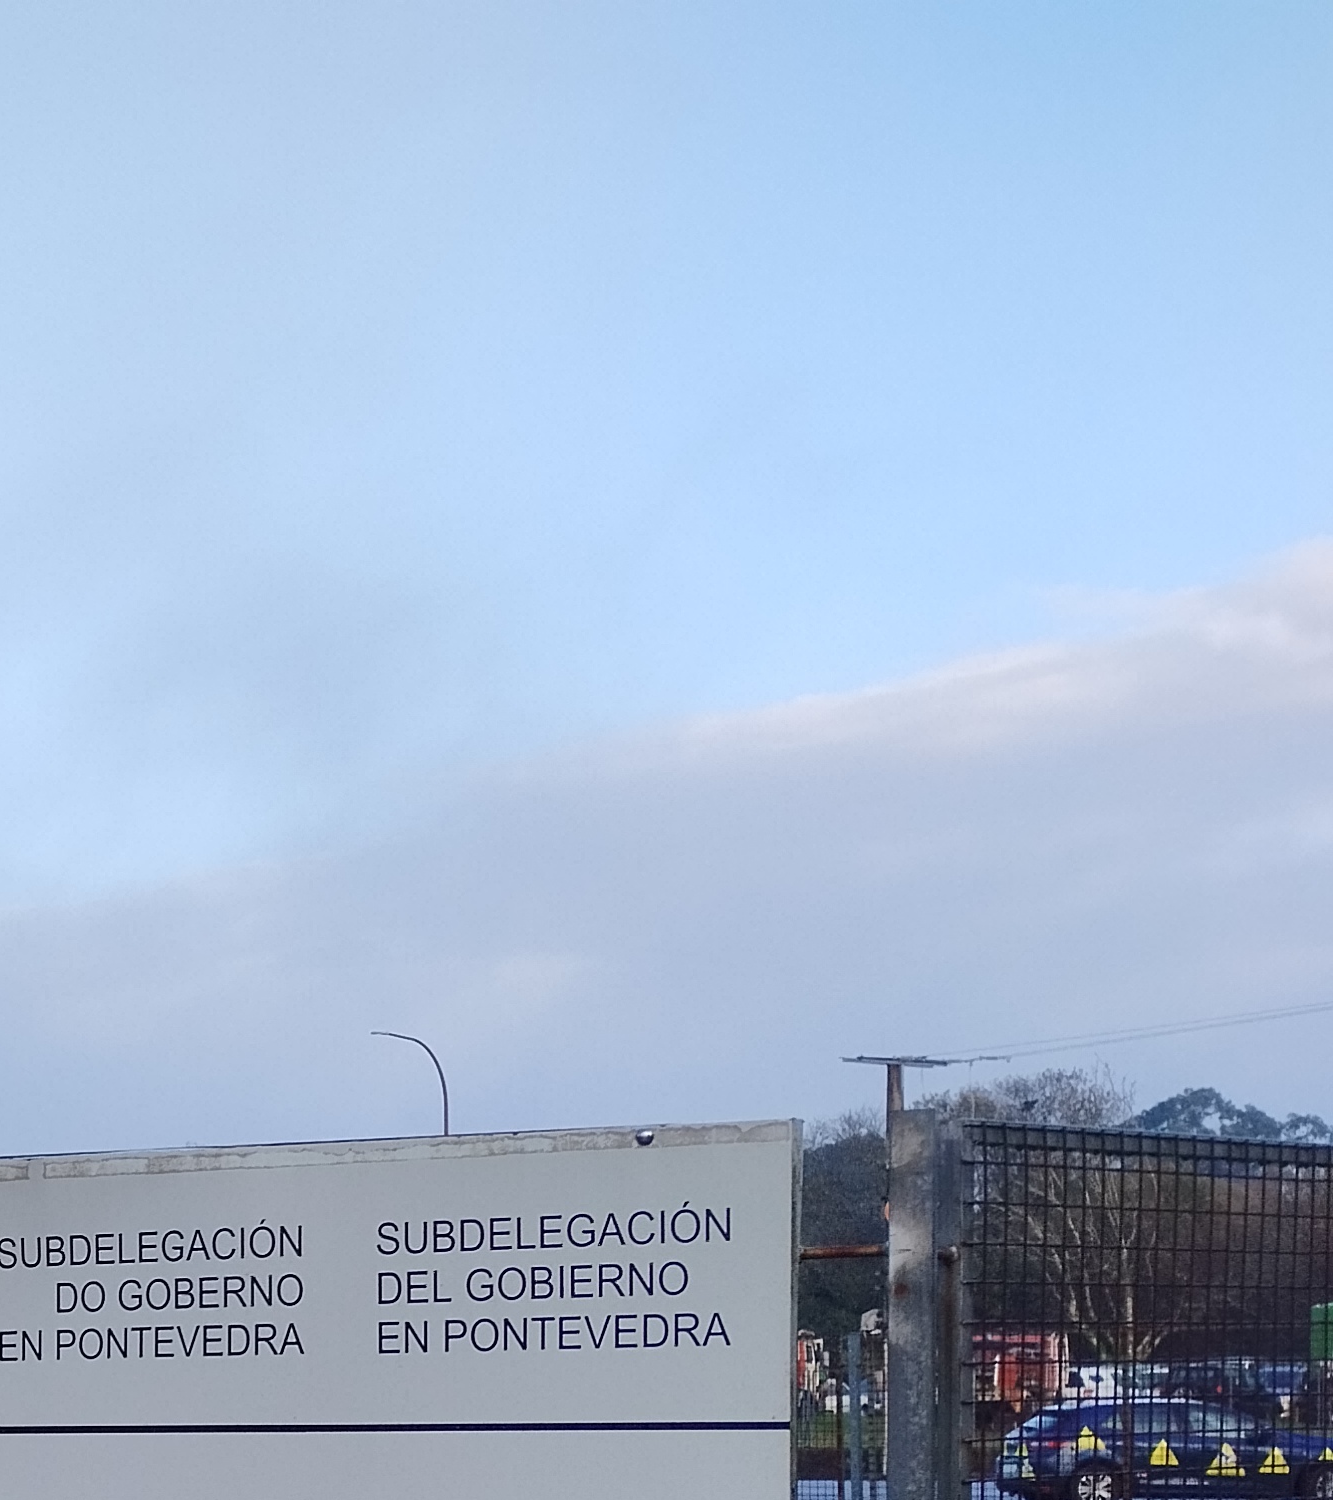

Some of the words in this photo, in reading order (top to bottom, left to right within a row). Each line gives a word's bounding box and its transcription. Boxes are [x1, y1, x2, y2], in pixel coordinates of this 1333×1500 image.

[377, 1201, 731, 1256] SUBDELEGACIÓN
[56, 1280, 106, 1314] DO
[119, 1273, 304, 1312] GOBERNO
[377, 1269, 452, 1305] DEL
[466, 1261, 689, 1302] GOBIERNO
[56, 1322, 305, 1361] PONTEVEDRA
[378, 1320, 428, 1355] EN
[444, 1312, 731, 1353] PONTEVEDRA
